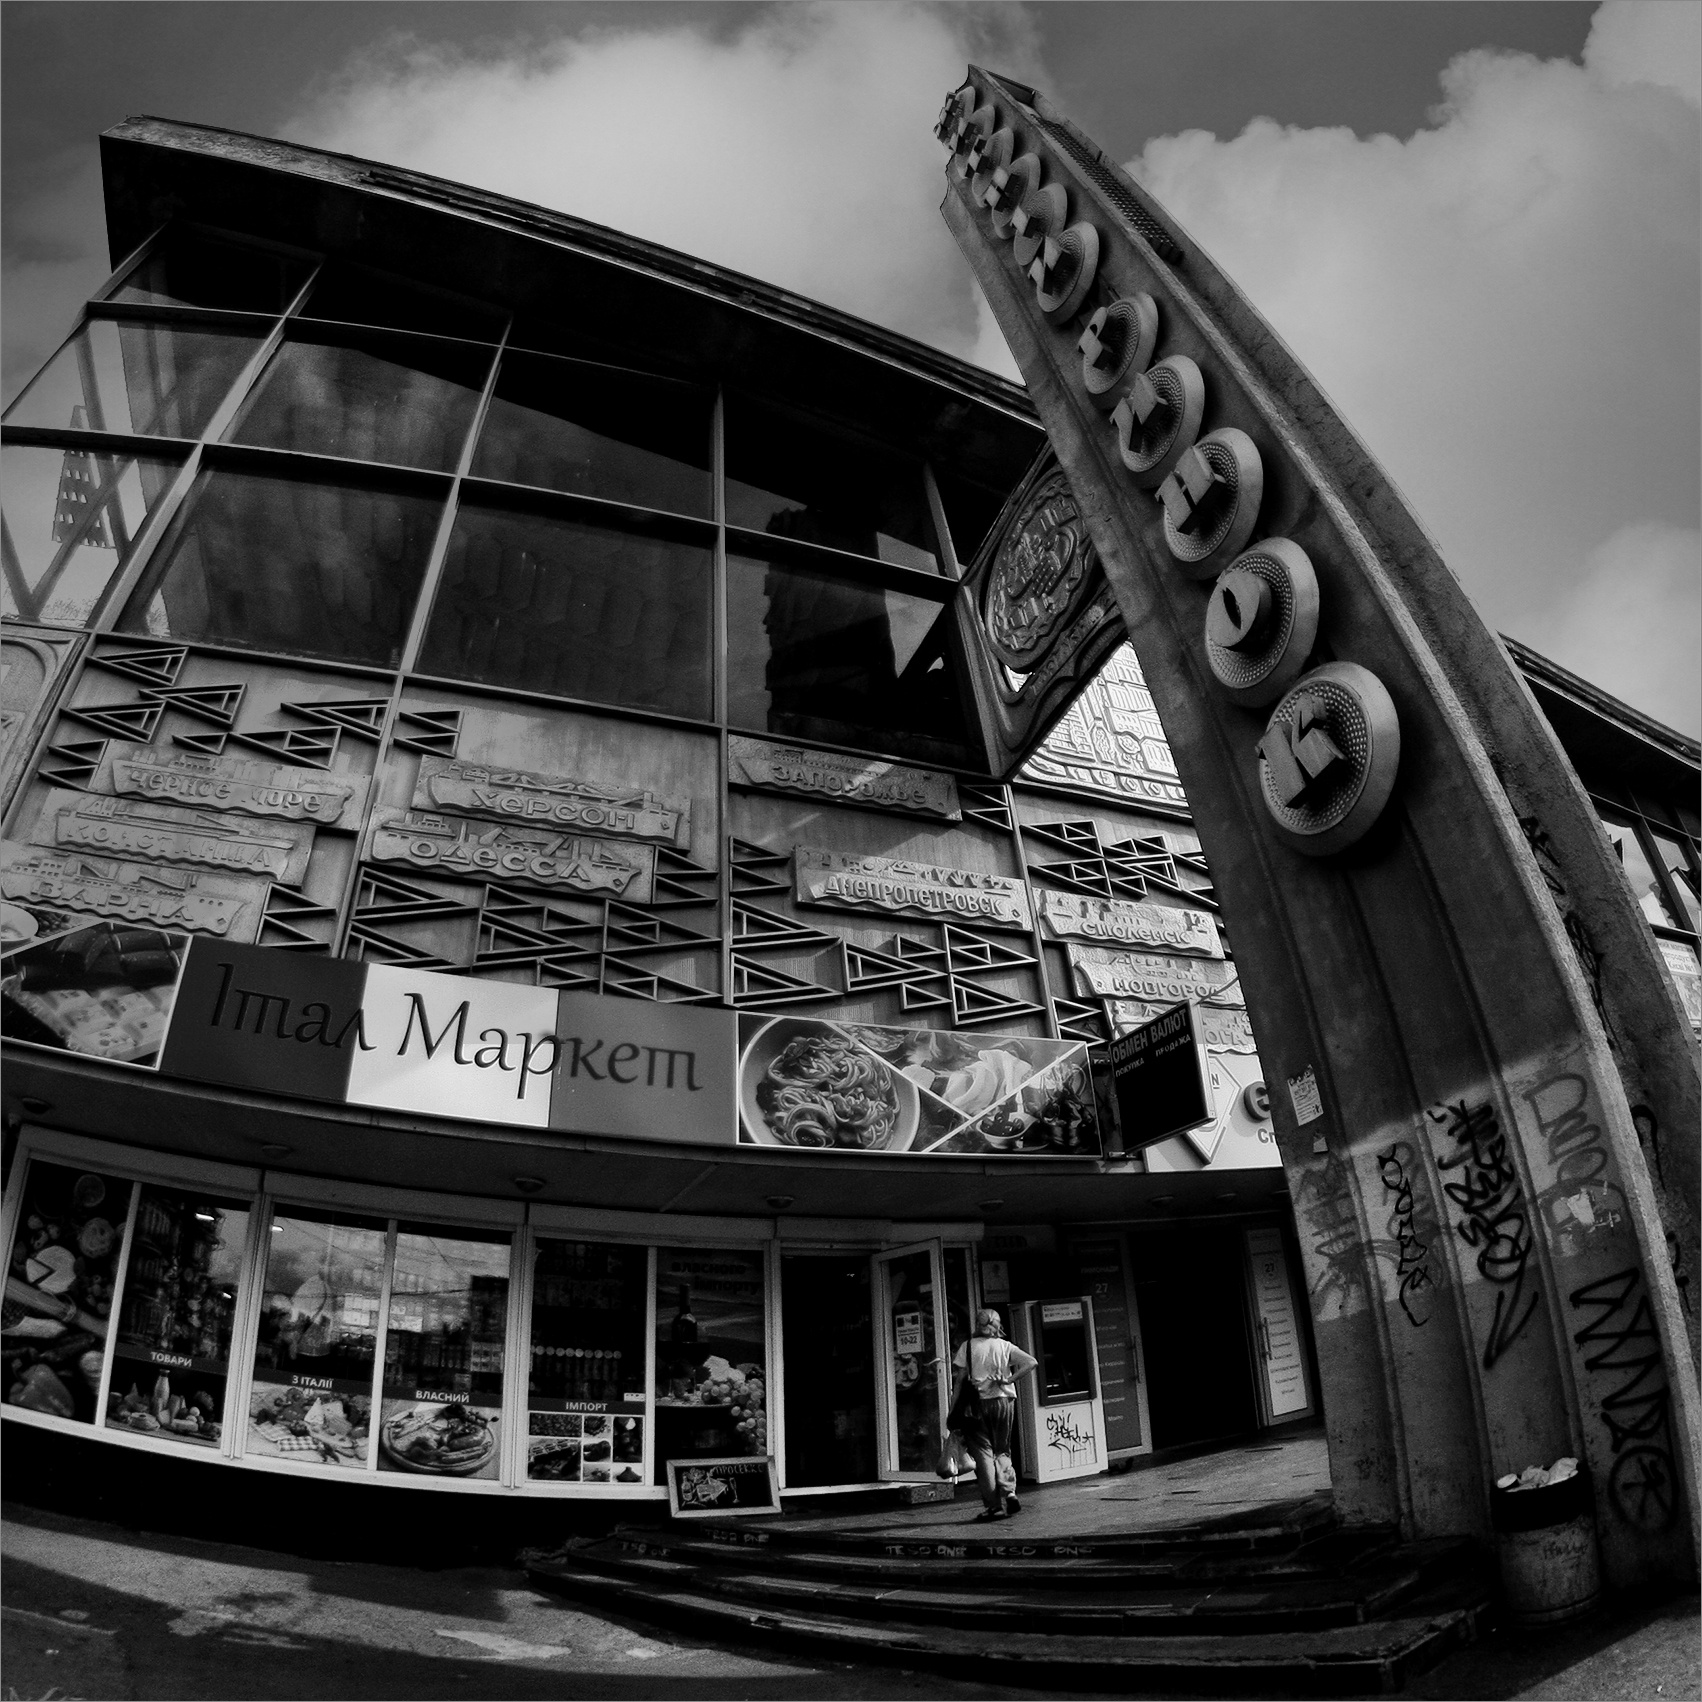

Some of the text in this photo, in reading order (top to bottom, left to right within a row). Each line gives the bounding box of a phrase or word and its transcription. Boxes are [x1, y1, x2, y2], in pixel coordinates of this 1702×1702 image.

[130, 769, 231, 799] ЧЕРНОЕ
[772, 766, 926, 803] ЗАПОРОЖЬЕ
[470, 788, 635, 829] ХЕРСОН
[409, 840, 591, 881] ОДЕССА
[29, 881, 195, 922] ВАРНА
[825, 876, 1004, 915] ДНЕПРОПЕТРОВСК
[1080, 919, 1190, 945] СМОЛЕНСК
[1113, 977, 1227, 1002] НОВГОРОД
[396, 992, 704, 1099] Маркет
[1112, 1008, 1187, 1063] ОБМЕН ВАЛЮТ
[1115, 1034, 1191, 1078] ПОКУПКА ПРОДАЖА
[671, 1262, 746, 1274] власного
[694, 1276, 762, 1295] імпорту
[1095, 1283, 1109, 1294] 27
[150, 1350, 193, 1368] ТОВАРИ
[291, 1375, 335, 1389] З ІТАЛІЇ
[415, 1389, 470, 1403] ВЛАСНИЙ
[565, 1402, 608, 1412] ІМПОРТ
